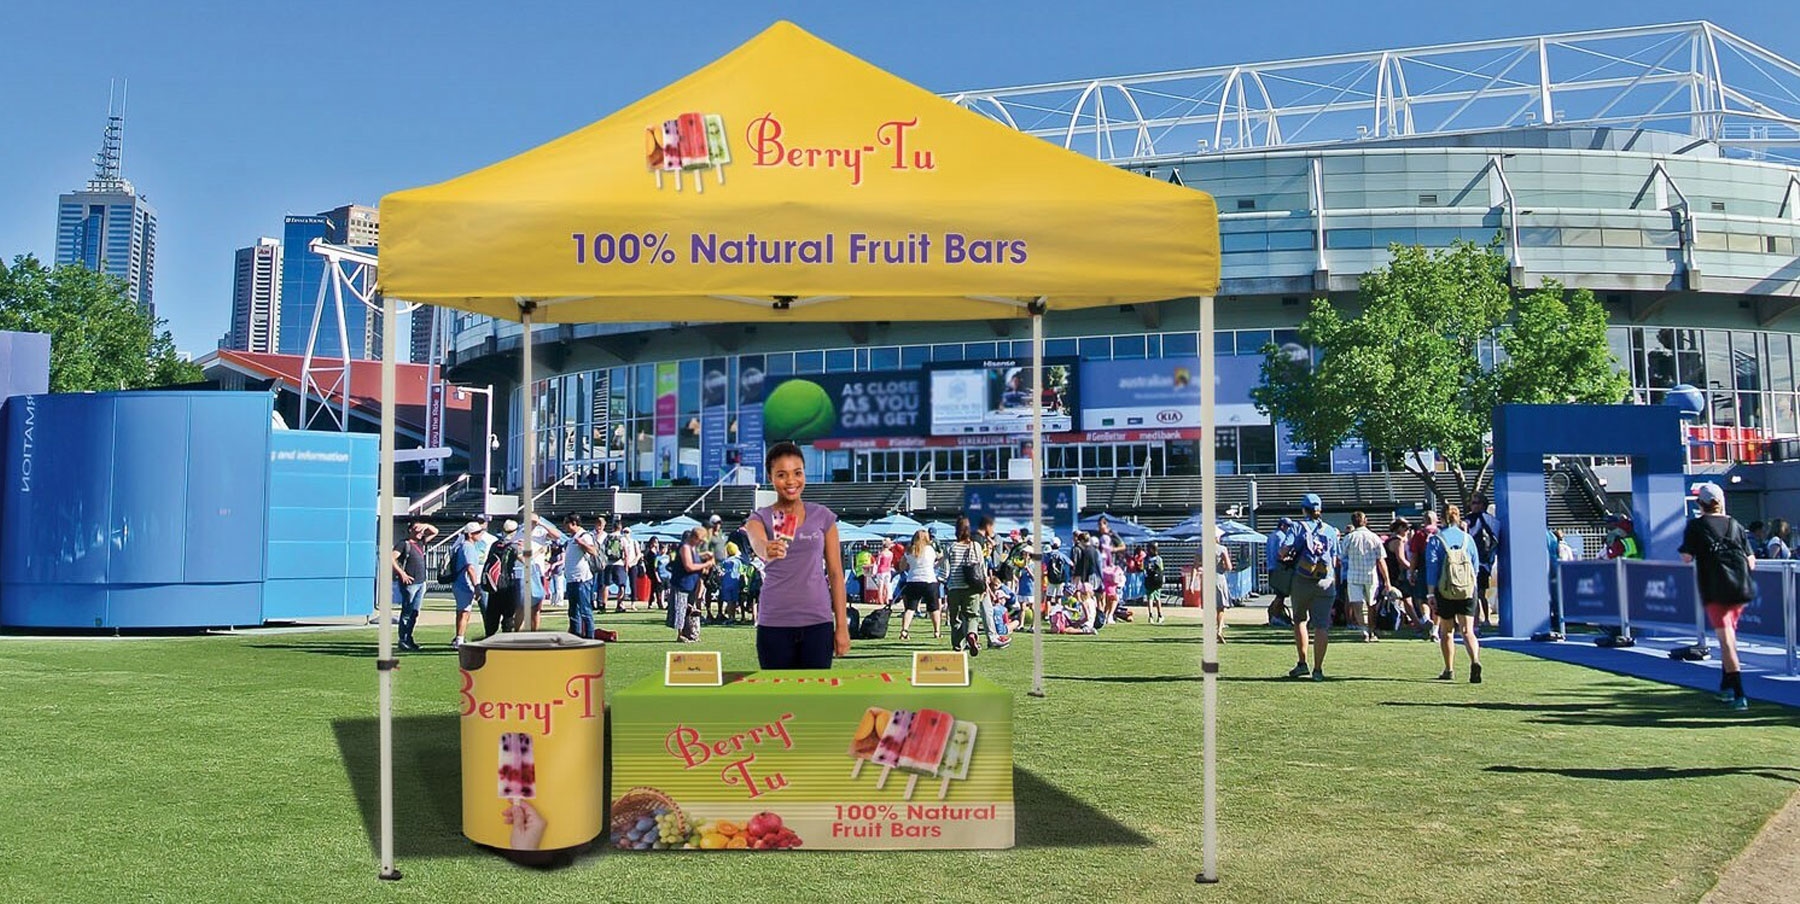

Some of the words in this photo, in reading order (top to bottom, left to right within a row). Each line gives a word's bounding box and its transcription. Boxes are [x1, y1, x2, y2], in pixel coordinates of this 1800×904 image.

[746, 112, 935, 185] Berry-Tu
[572, 233, 676, 264] 100%
[691, 233, 834, 263] Natural
[850, 233, 930, 263] Fruit
[945, 233, 1027, 263] Bars
[842, 383, 863, 396] AS
[867, 381, 919, 395] CLOSE
[842, 396, 870, 413] AS
[876, 394, 919, 411] YOU
[842, 412, 879, 428] CAN
[884, 411, 918, 427] GET
[1139, 430, 1182, 440] medibank
[721, 752, 788, 799] Tu
[834, 804, 899, 820] 100%
[907, 804, 996, 820] Natural
[832, 822, 882, 838] Fruit
[891, 822, 942, 838] Bars
